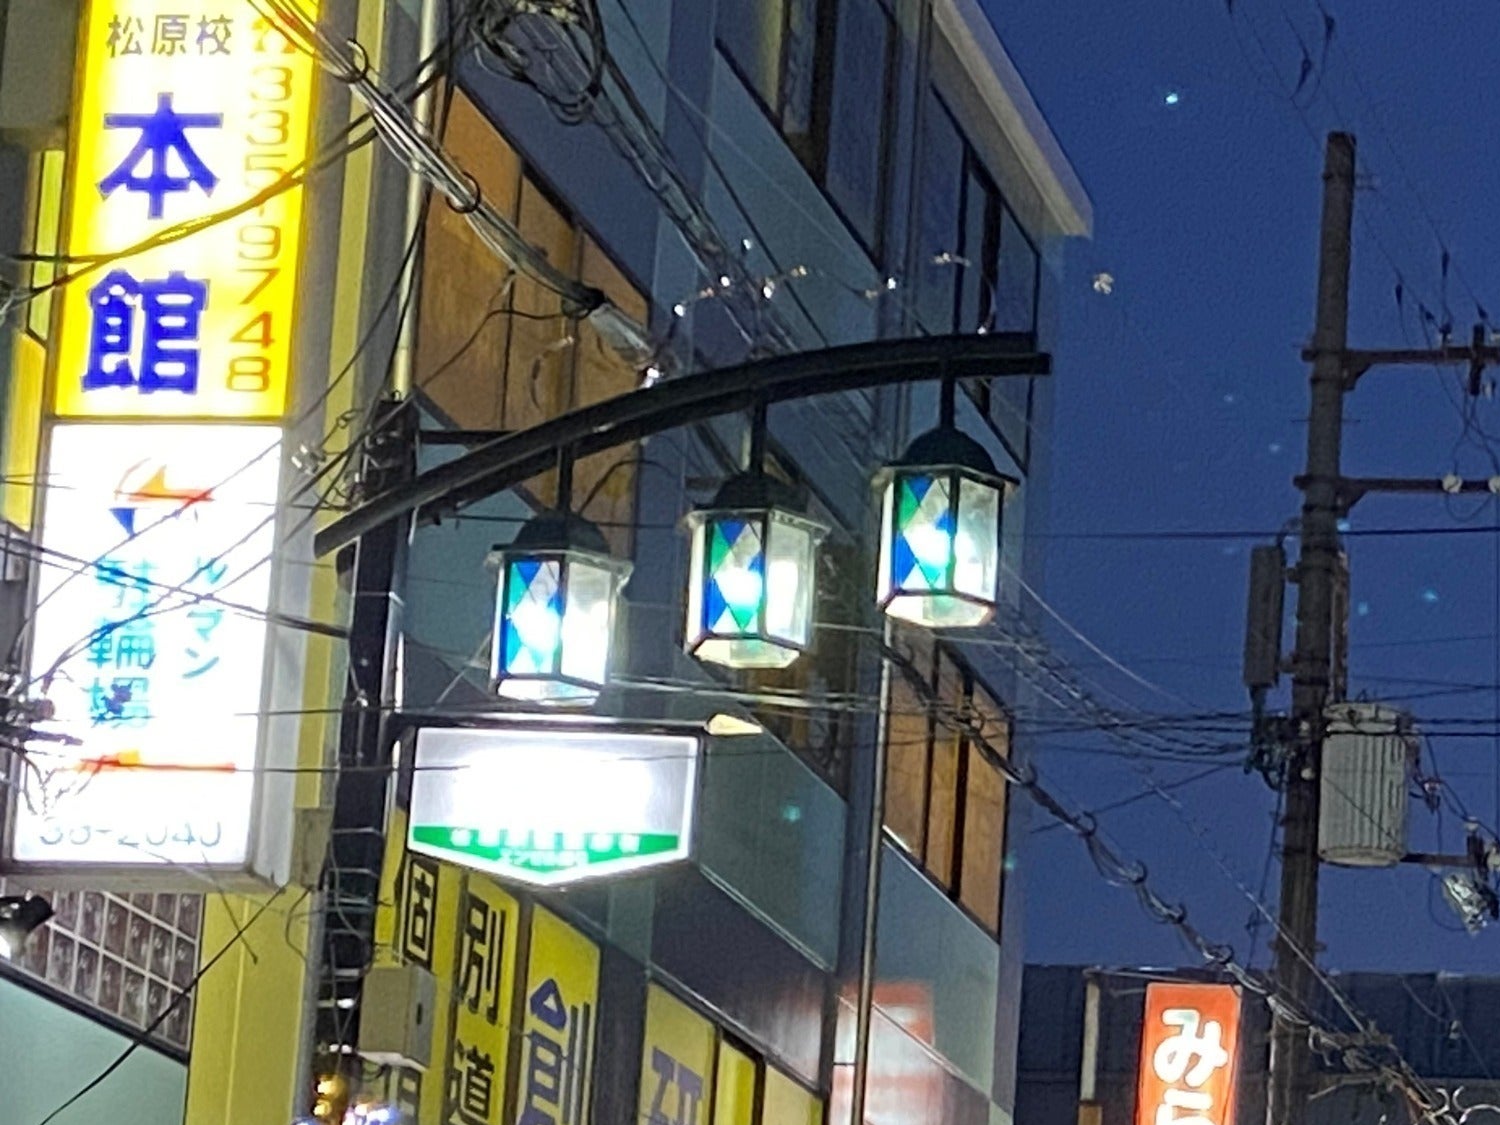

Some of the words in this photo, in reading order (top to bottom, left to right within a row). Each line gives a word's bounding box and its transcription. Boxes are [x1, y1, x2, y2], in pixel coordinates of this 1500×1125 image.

[106, 13, 235, 58] 松原校
[80, 92, 224, 395] 本館
